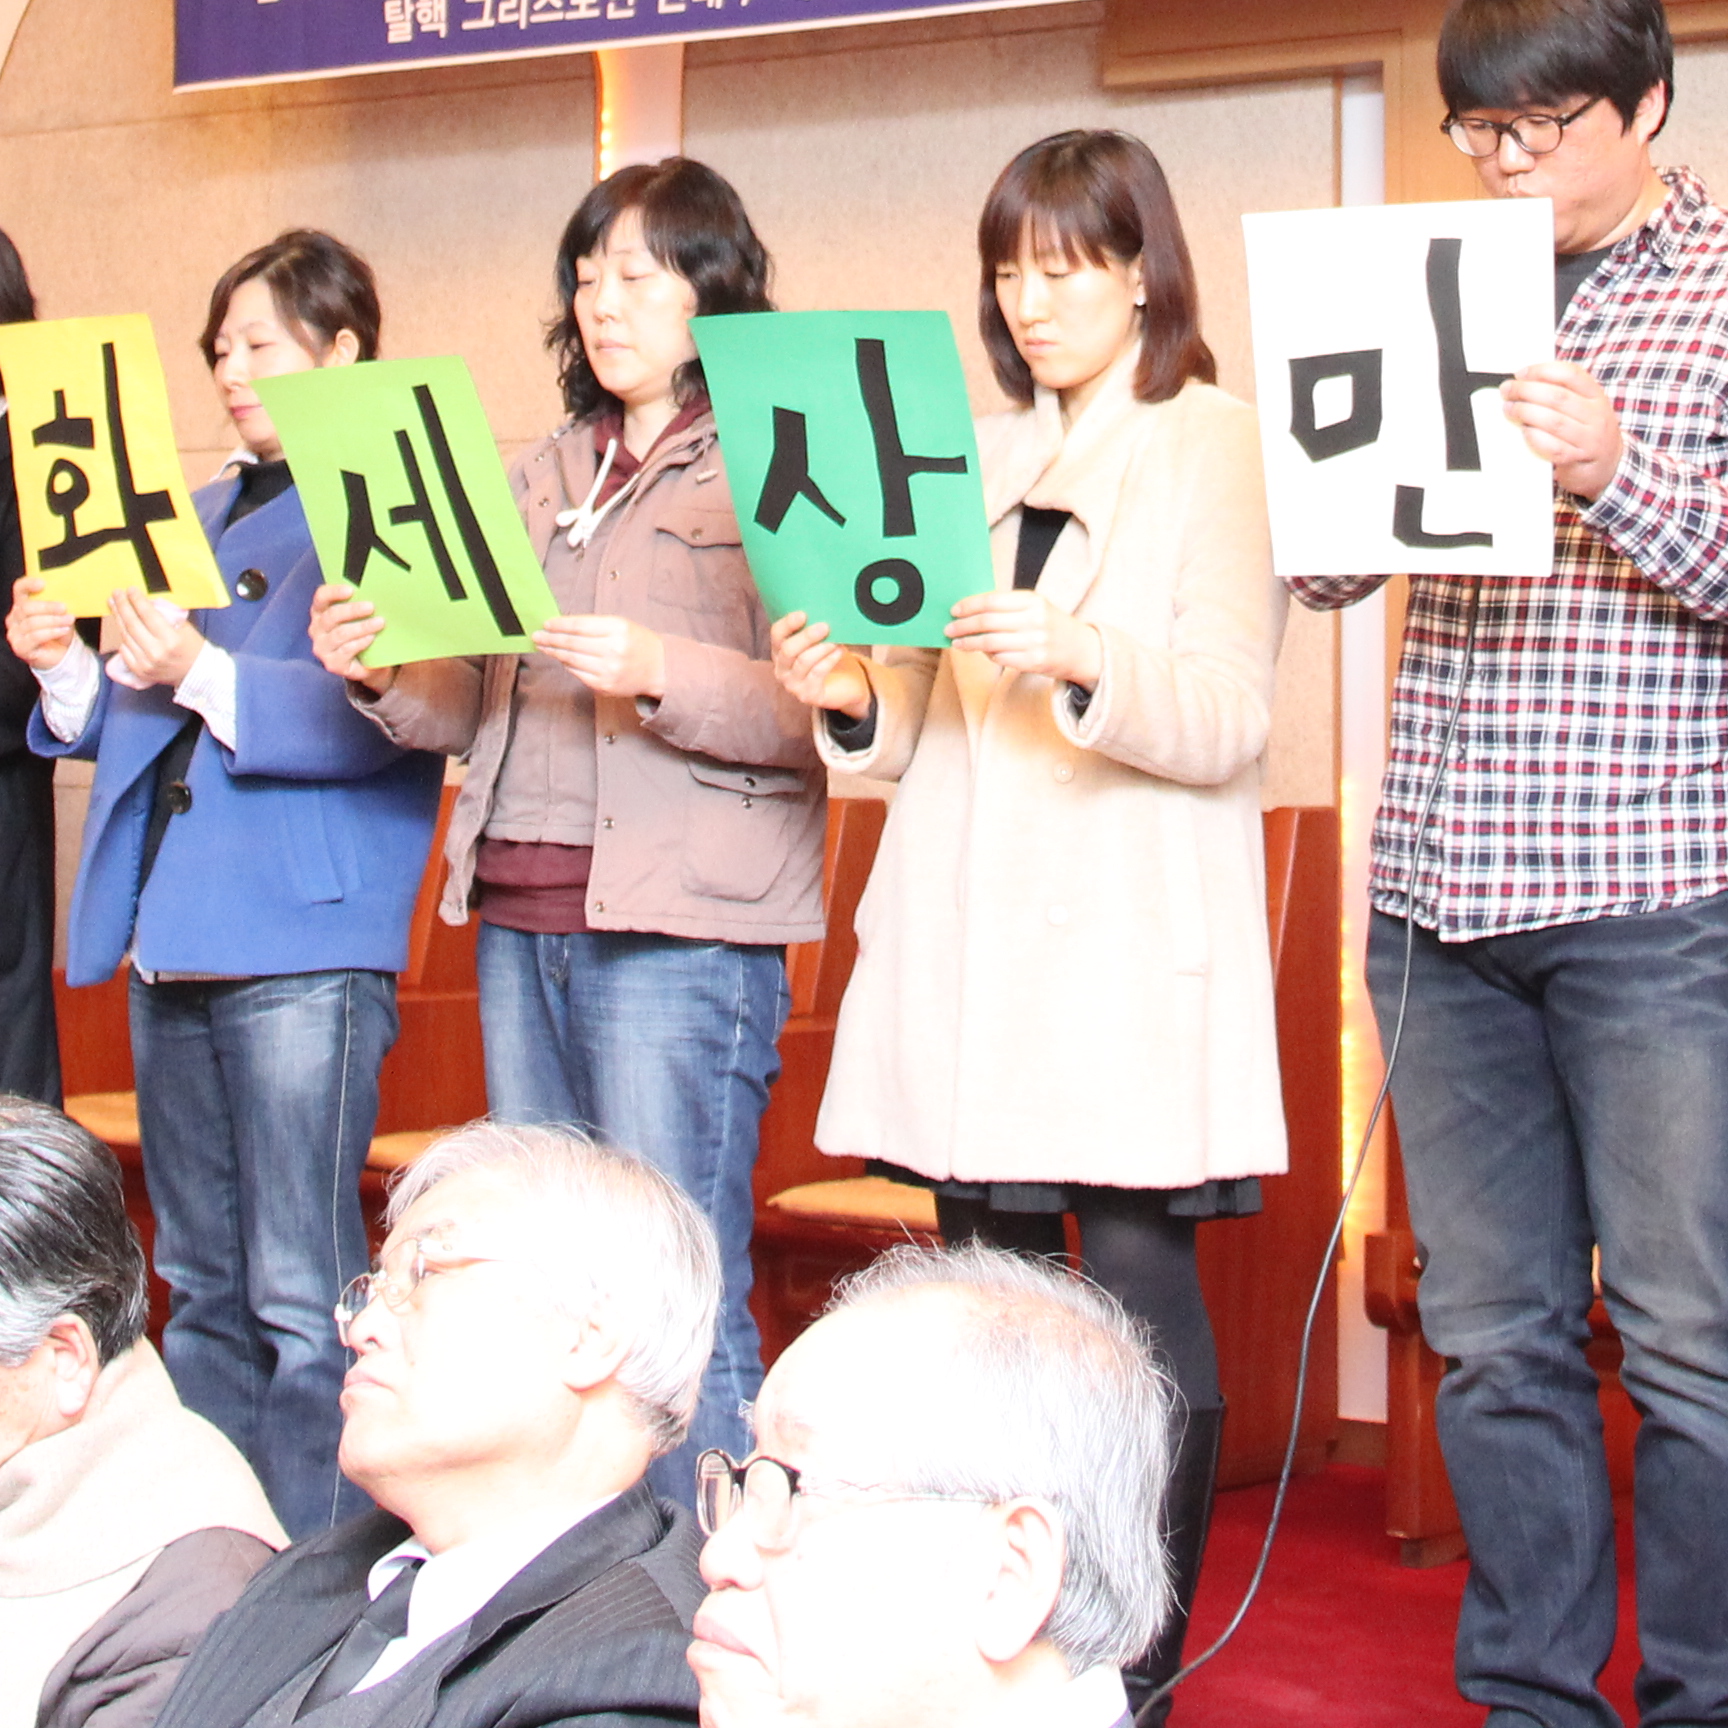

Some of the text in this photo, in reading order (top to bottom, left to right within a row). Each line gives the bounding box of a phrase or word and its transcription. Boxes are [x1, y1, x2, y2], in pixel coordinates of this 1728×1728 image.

[31, 342, 176, 592] 화
[342, 384, 524, 636] 세
[754, 338, 968, 627] 상
[1288, 238, 1514, 549] 만
